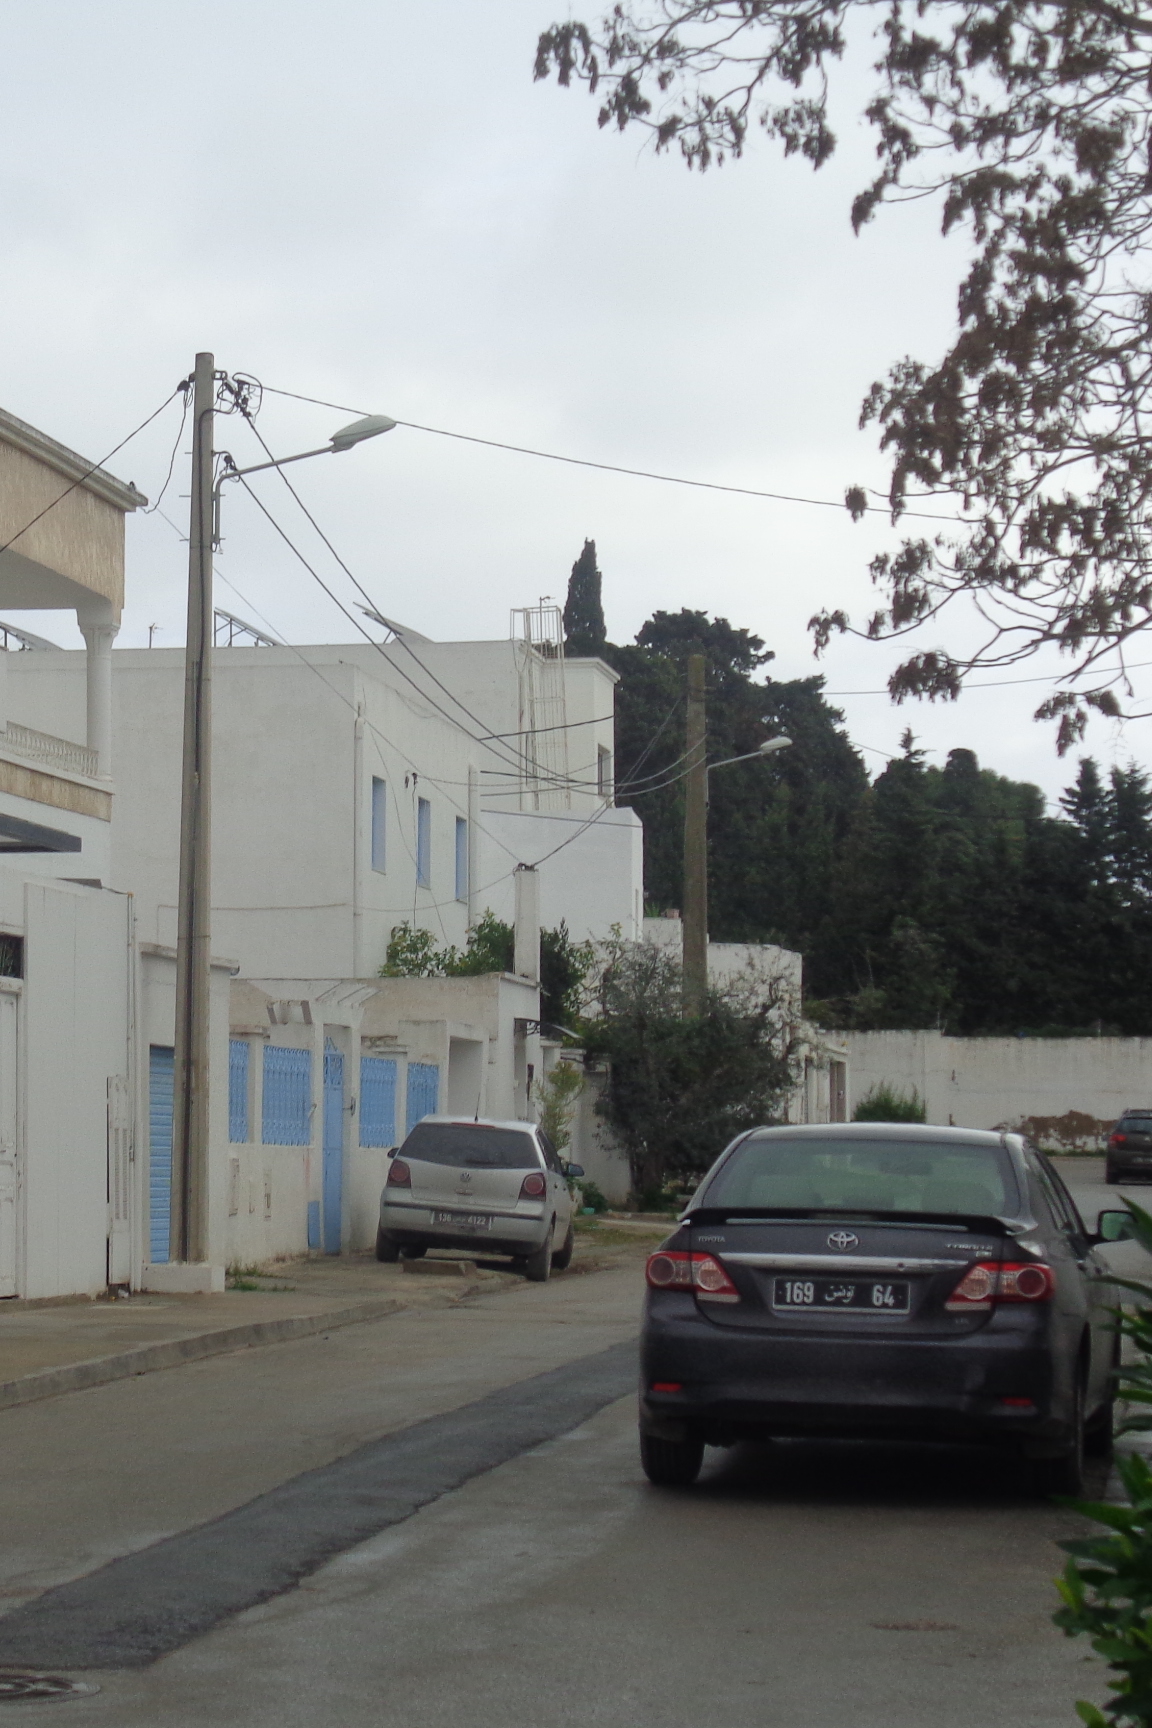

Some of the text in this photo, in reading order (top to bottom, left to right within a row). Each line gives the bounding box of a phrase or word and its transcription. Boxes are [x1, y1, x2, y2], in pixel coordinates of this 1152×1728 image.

[698, 1235, 726, 1243] TOYOTA
[785, 1282, 895, 1307] 169 تونس 64
